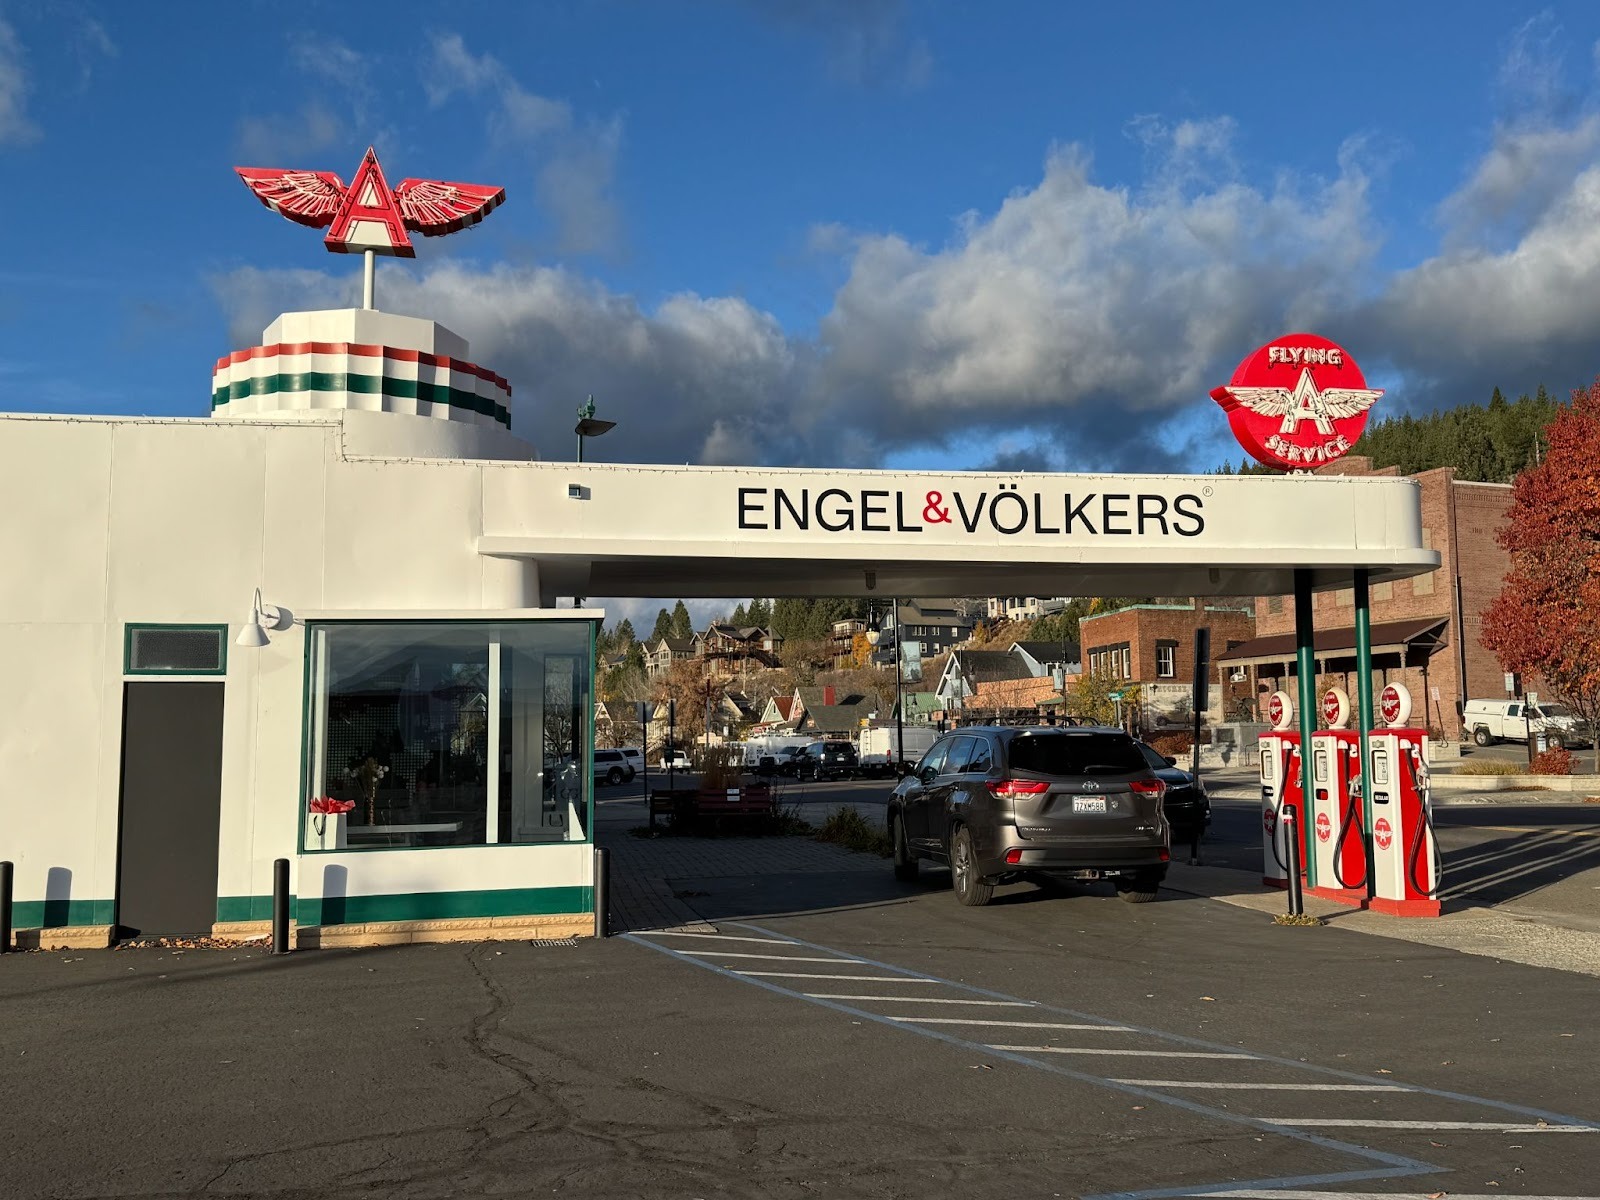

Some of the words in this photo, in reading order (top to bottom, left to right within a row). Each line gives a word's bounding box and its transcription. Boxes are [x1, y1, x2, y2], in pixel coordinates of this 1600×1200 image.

[1268, 346, 1343, 366] FLYING
[1279, 367, 1337, 435] A
[1265, 434, 1352, 463] SERVICE
[1074, 802, 1104, 811] 7ZXM588
